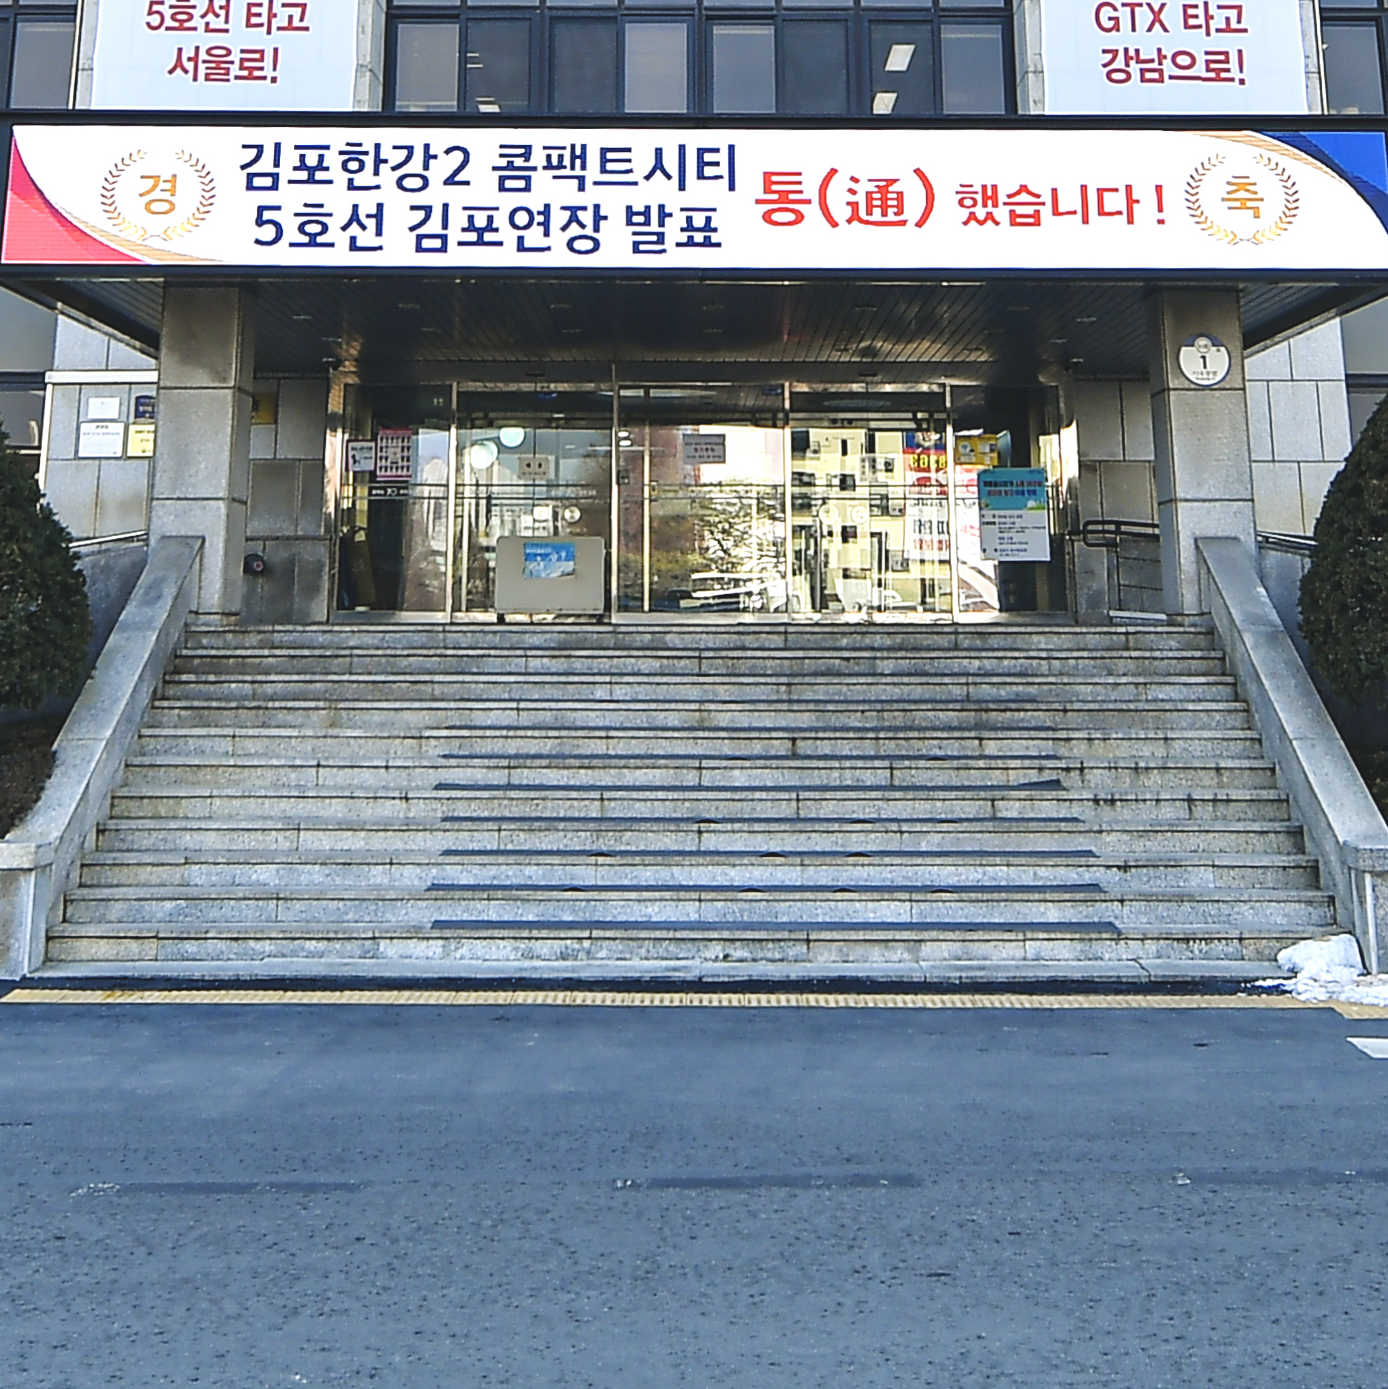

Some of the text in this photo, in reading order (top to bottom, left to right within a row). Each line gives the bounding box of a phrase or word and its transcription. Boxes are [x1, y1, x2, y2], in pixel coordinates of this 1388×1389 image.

[1095, 0, 1249, 36] GTX 타고
[168, 46, 279, 84] 서울로!
[1101, 47, 1246, 85] 강남으로!
[239, 141, 736, 193] 김포한강2 콤팩트시티
[138, 173, 178, 216] 경
[755, 167, 935, 229] 통(通)
[1221, 175, 1265, 219] 축
[253, 202, 723, 255] 5호선 김포연장 발표
[1200, 355, 1207, 370] 1
